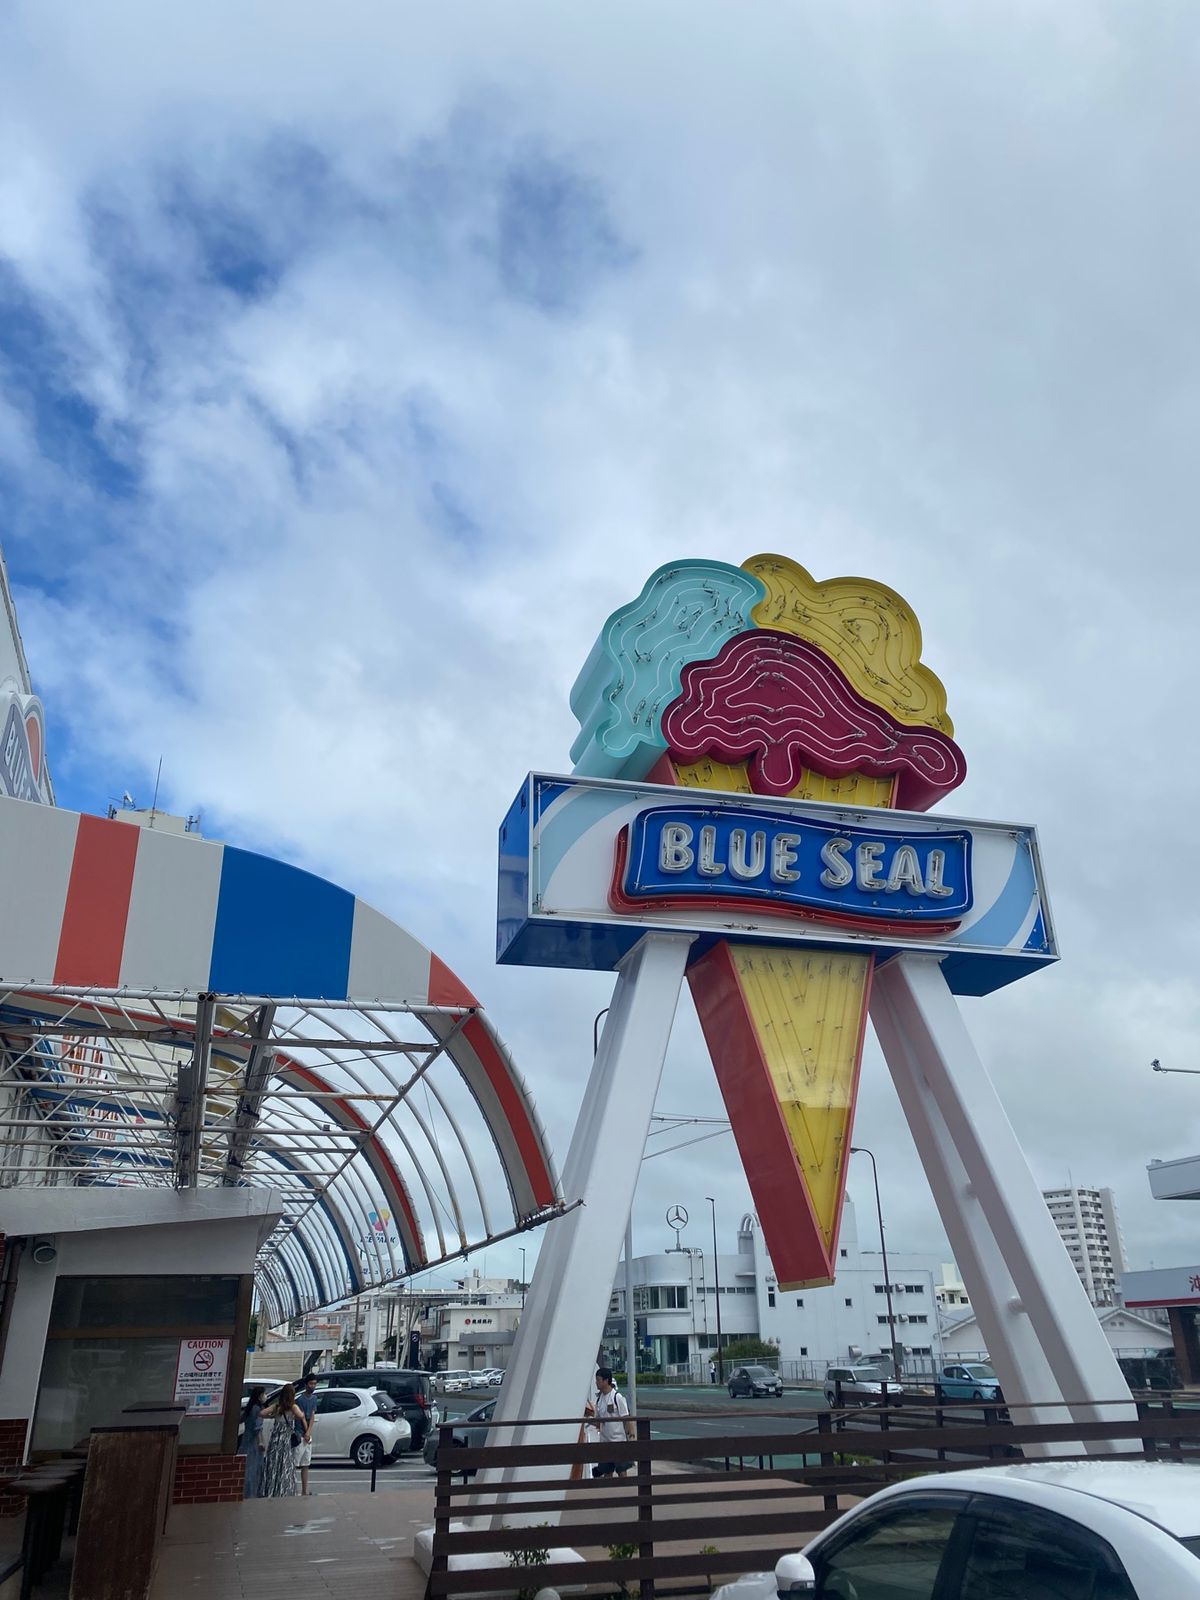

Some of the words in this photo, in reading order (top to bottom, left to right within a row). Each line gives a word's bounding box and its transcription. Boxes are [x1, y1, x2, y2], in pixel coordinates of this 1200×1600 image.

[659, 821, 801, 884] BLUE
[820, 837, 954, 899] SEAL
[187, 1340, 224, 1349] CAUTION
